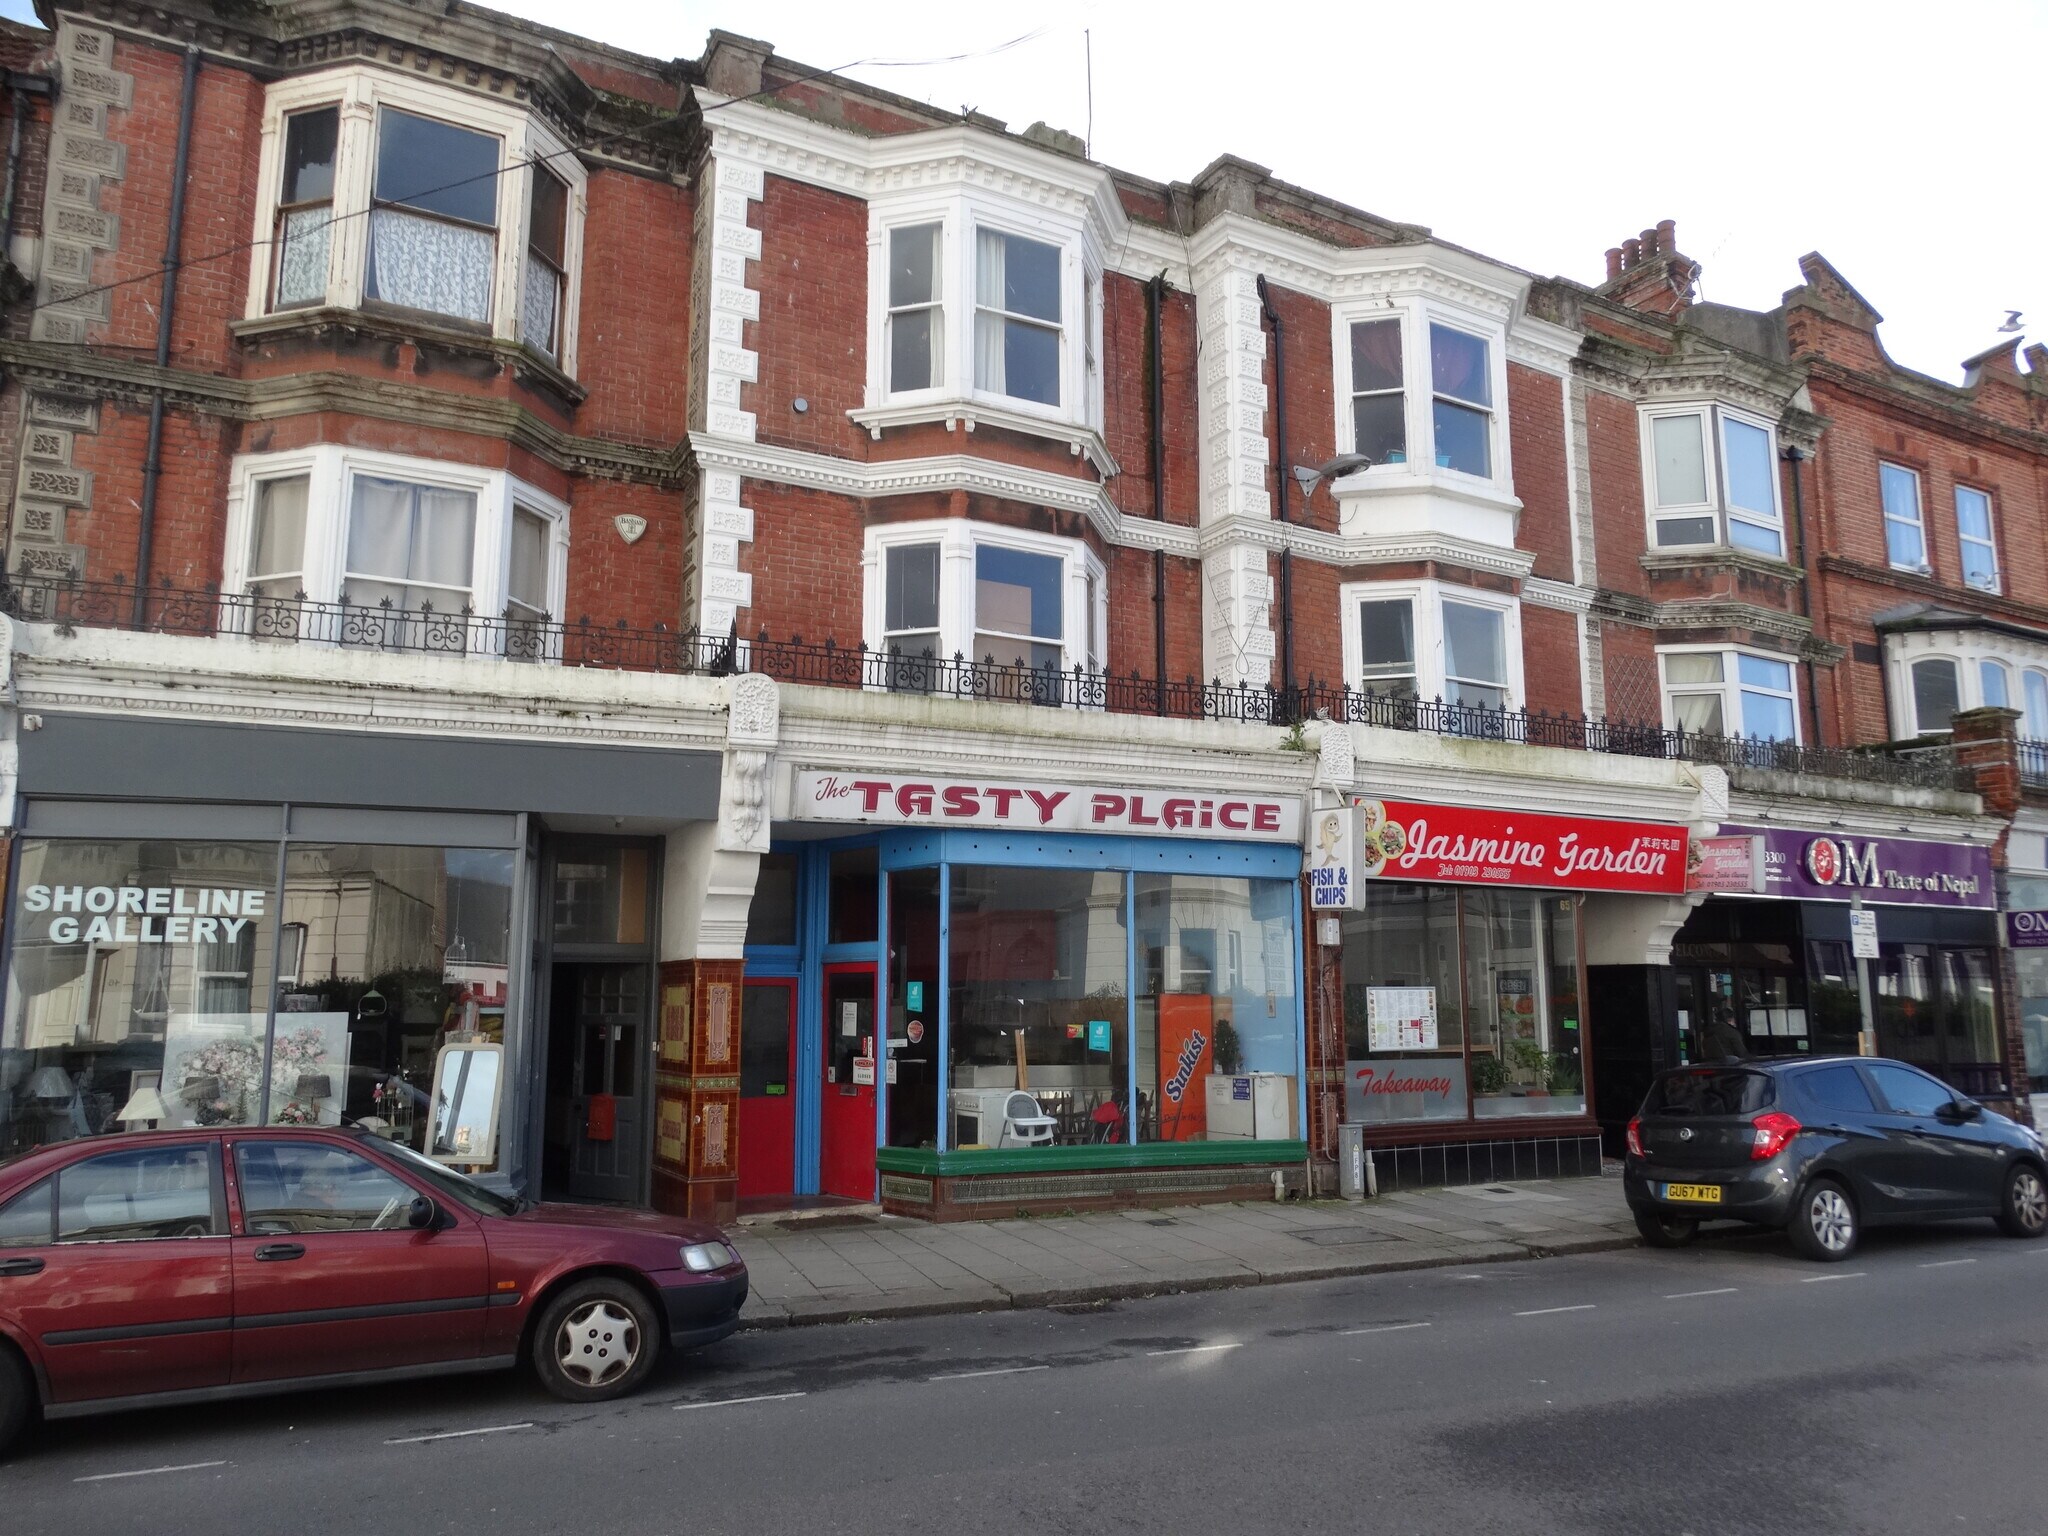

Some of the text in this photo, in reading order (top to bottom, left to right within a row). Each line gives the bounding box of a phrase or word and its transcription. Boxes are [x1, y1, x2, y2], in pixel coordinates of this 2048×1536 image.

[815, 777, 851, 801] The
[850, 781, 1071, 825] TASTY
[1400, 819, 1667, 876] Jasmine Garden
[1702, 844, 1741, 859] Jasmine
[1312, 867, 1348, 886] FISH &
[1454, 865, 1478, 877] 01903
[1482, 867, 1511, 879] 230555
[1714, 857, 1748, 870] Garden
[1805, 837, 1979, 898] OM Taste of Nepal
[23, 885, 266, 916] SHORELINE
[1315, 887, 1346, 905] CHIPS
[48, 916, 249, 943] GALLERY
[1164, 1028, 1208, 1102] Sunkist
[1356, 1068, 1451, 1099] Takeaway
[1669, 1185, 1695, 1197] GU67
[1697, 1187, 1718, 1199] WTG
